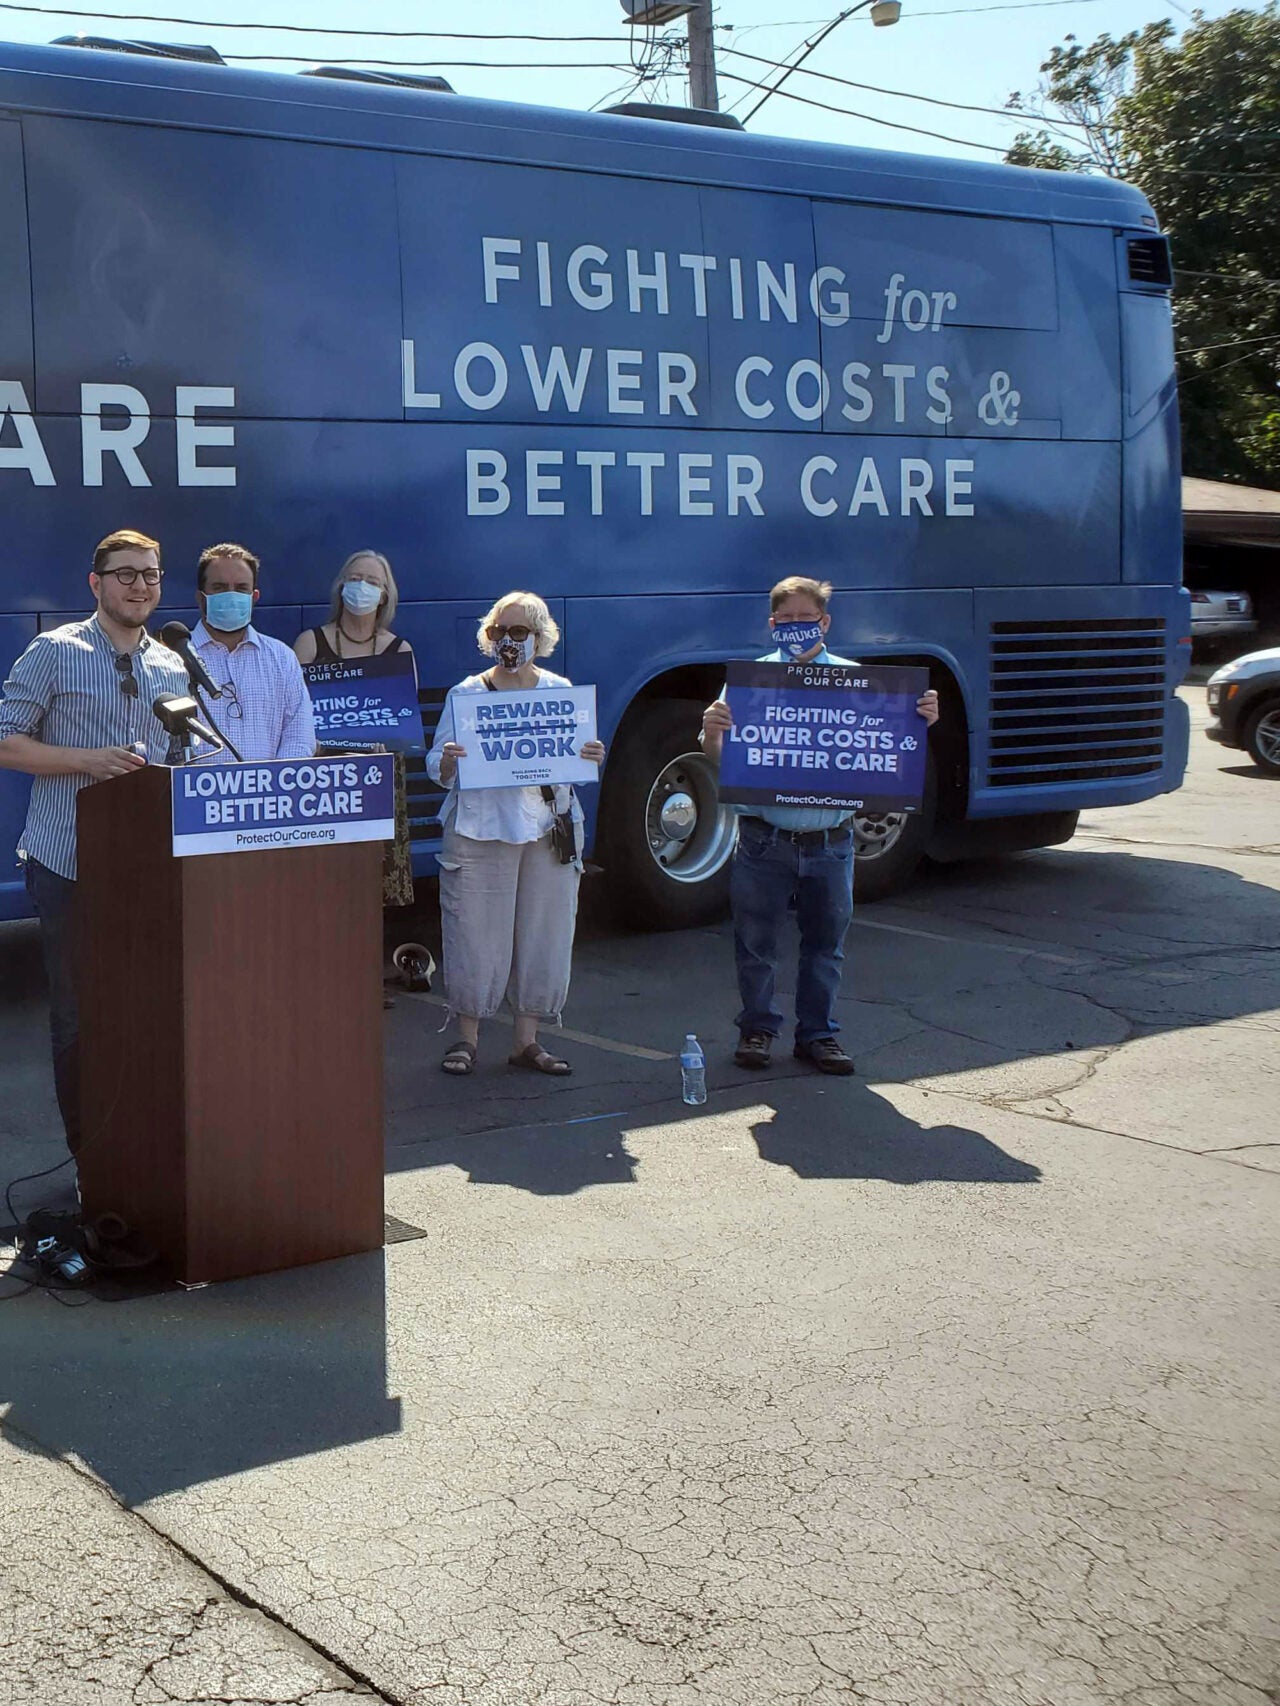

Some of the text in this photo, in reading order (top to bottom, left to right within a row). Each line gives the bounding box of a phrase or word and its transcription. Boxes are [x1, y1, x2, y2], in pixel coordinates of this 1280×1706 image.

[481, 237, 957, 344] FIGHTING for
[401, 339, 1020, 426] LOWER COSTS &
[465, 449, 975, 518] BETTER CARE
[310, 668, 363, 681] OUR CARE
[787, 666, 848, 677] PROTECT
[803, 676, 869, 688] OUR CARE
[363, 697, 381, 708] for
[476, 700, 575, 721] REWARD
[329, 708, 393, 723] COSTS
[398, 707, 412, 717] &
[765, 706, 884, 727] FIGHTING for
[479, 719, 575, 739] WEALTH
[730, 725, 918, 751] LOWER COSTS &
[480, 736, 576, 761] WORK
[747, 747, 898, 772] BETTER CARE
[184, 763, 383, 797] LOWER COSTS &
[205, 790, 363, 824] BETTER CARE
[776, 794, 864, 809] ProtectOurCare.org
[236, 828, 336, 845] ProtectOurCare.org
